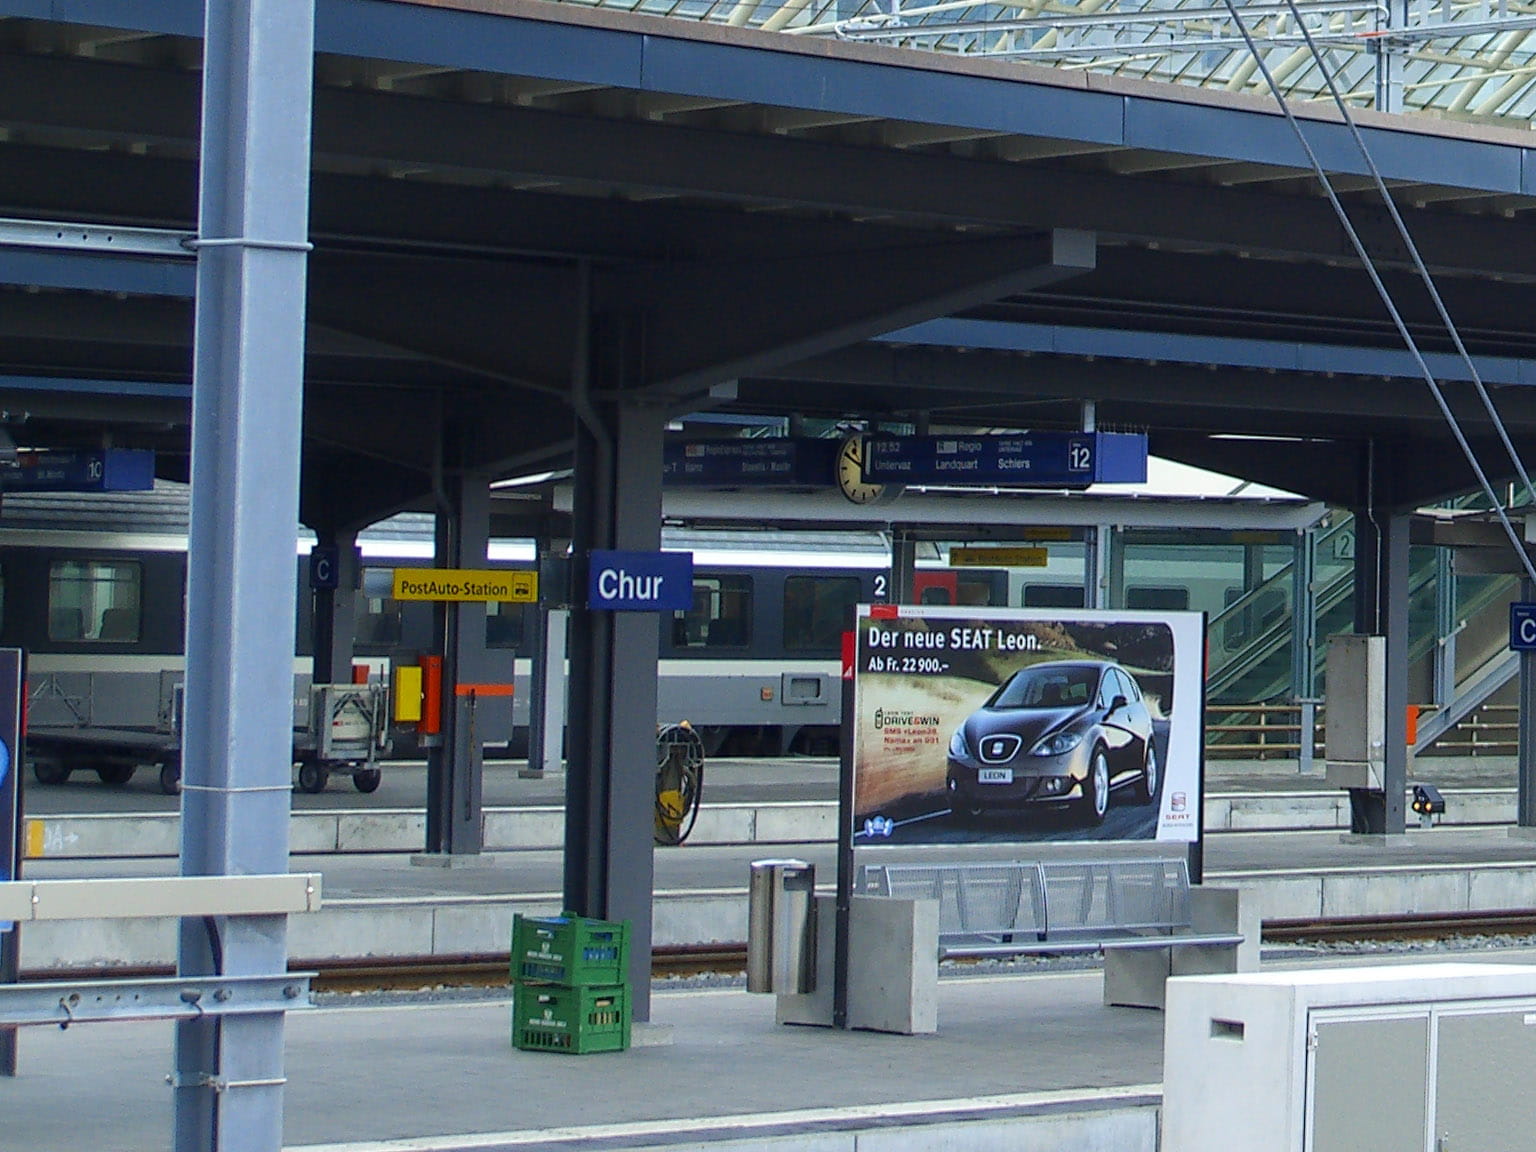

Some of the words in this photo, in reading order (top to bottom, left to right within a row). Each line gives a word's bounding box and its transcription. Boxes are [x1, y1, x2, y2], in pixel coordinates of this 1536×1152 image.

[874, 459, 911, 470] Untervaz
[935, 459, 979, 471] Landquart
[997, 458, 1031, 469] Schiers
[1071, 447, 1091, 469] 12
[88, 461, 102, 479] 10
[317, 559, 329, 581] C
[401, 580, 508, 596] PostAuto-Station
[598, 568, 664, 600] Chur
[874, 574, 886, 596] 2
[868, 626, 899, 648] Der
[904, 631, 945, 649] neue
[950, 628, 993, 650] SEAT
[997, 629, 1042, 651] Leon.
[1520, 618, 1536, 644] C
[868, 656, 884, 672] Ab
[886, 657, 900, 672] Fr.
[983, 771, 1007, 780] LEON
